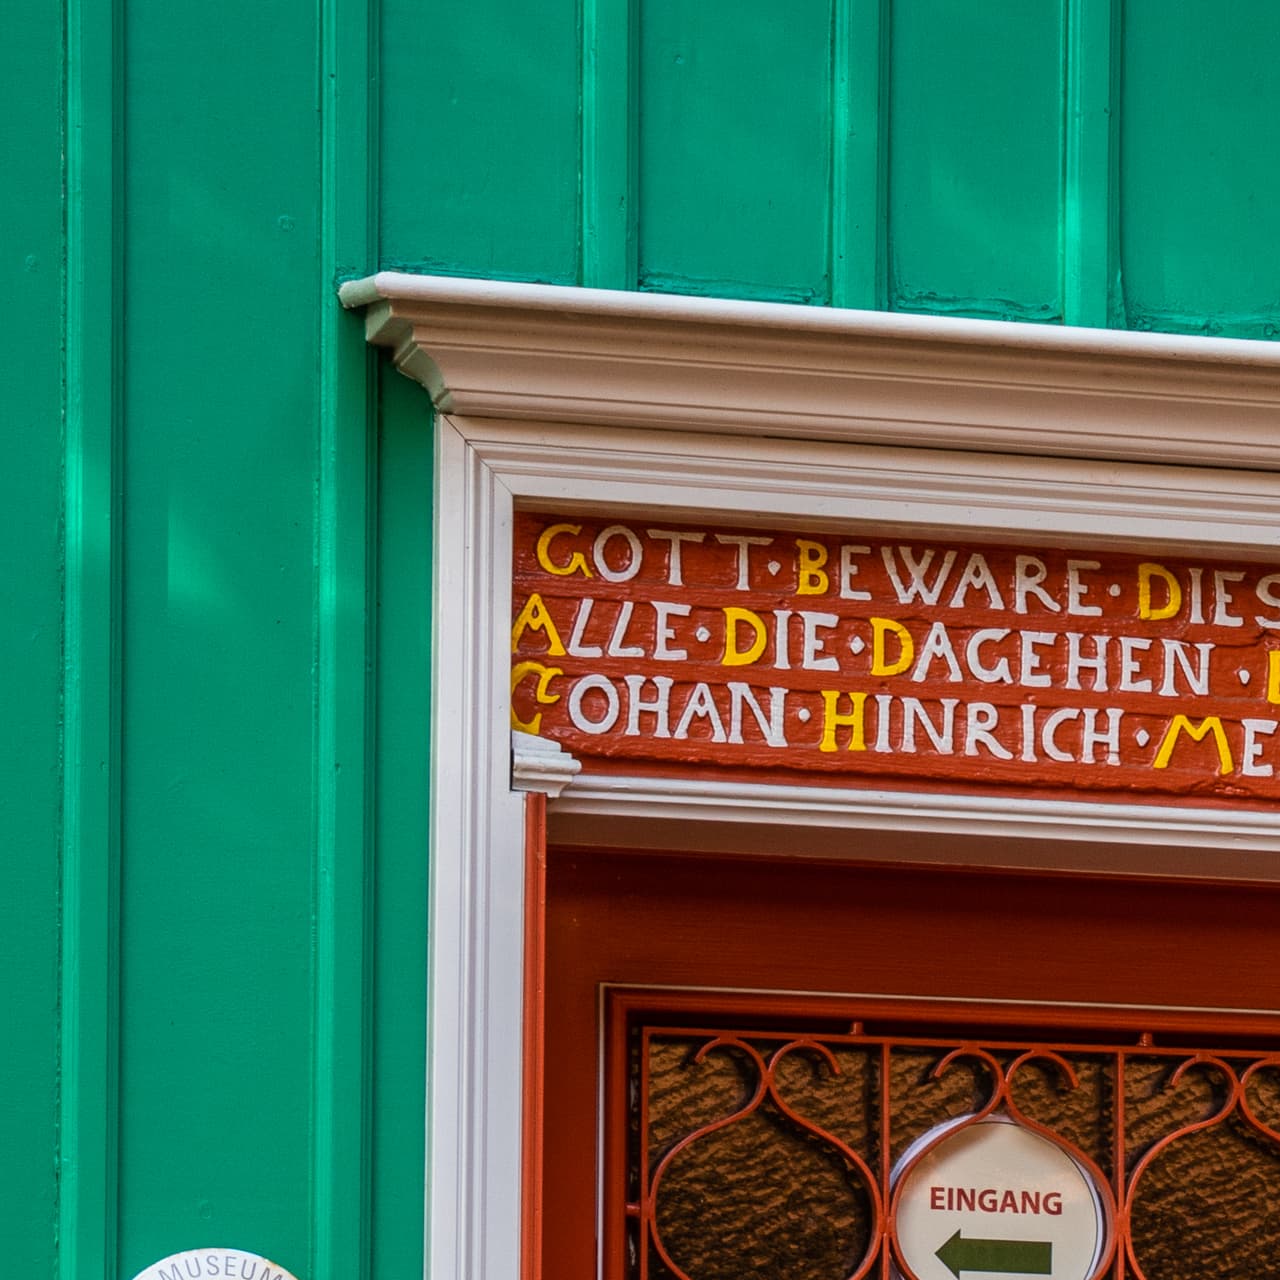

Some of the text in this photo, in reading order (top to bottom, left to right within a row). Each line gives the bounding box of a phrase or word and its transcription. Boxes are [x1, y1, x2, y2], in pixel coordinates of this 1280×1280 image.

[536, 523, 774, 592] GOTT
[796, 538, 1102, 617] BEWARE
[511, 592, 692, 661] ALLE
[721, 606, 839, 672] DIE
[819, 691, 1125, 767] HINRICH
[929, 1186, 1063, 1216] EINGANG
